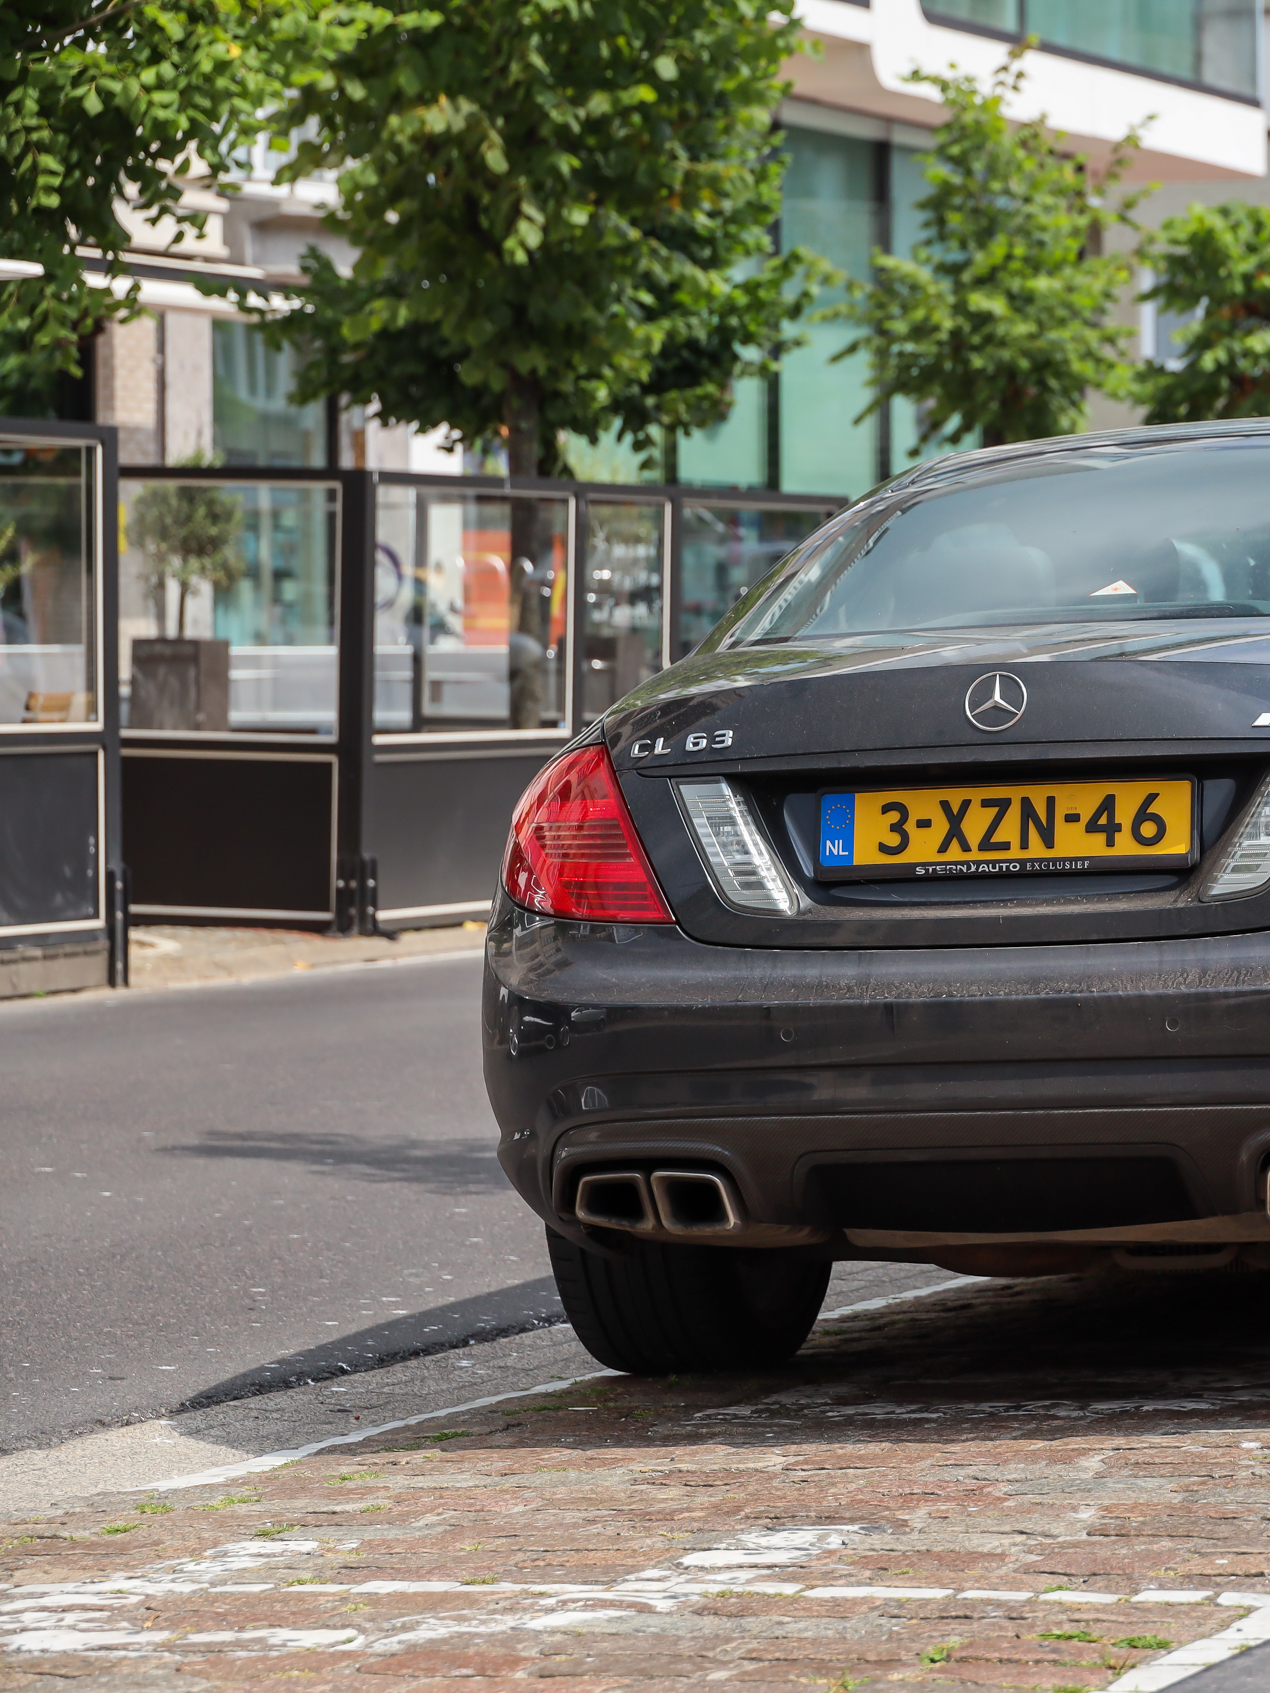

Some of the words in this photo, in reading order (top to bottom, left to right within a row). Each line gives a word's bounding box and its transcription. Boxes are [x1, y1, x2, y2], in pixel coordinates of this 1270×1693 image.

[630, 737, 672, 758] CL
[685, 729, 734, 752] 63
[877, 792, 1168, 856] 3-XZN-46
[825, 839, 849, 857] NL
[1026, 860, 1091, 871] EXCLUSIEF
